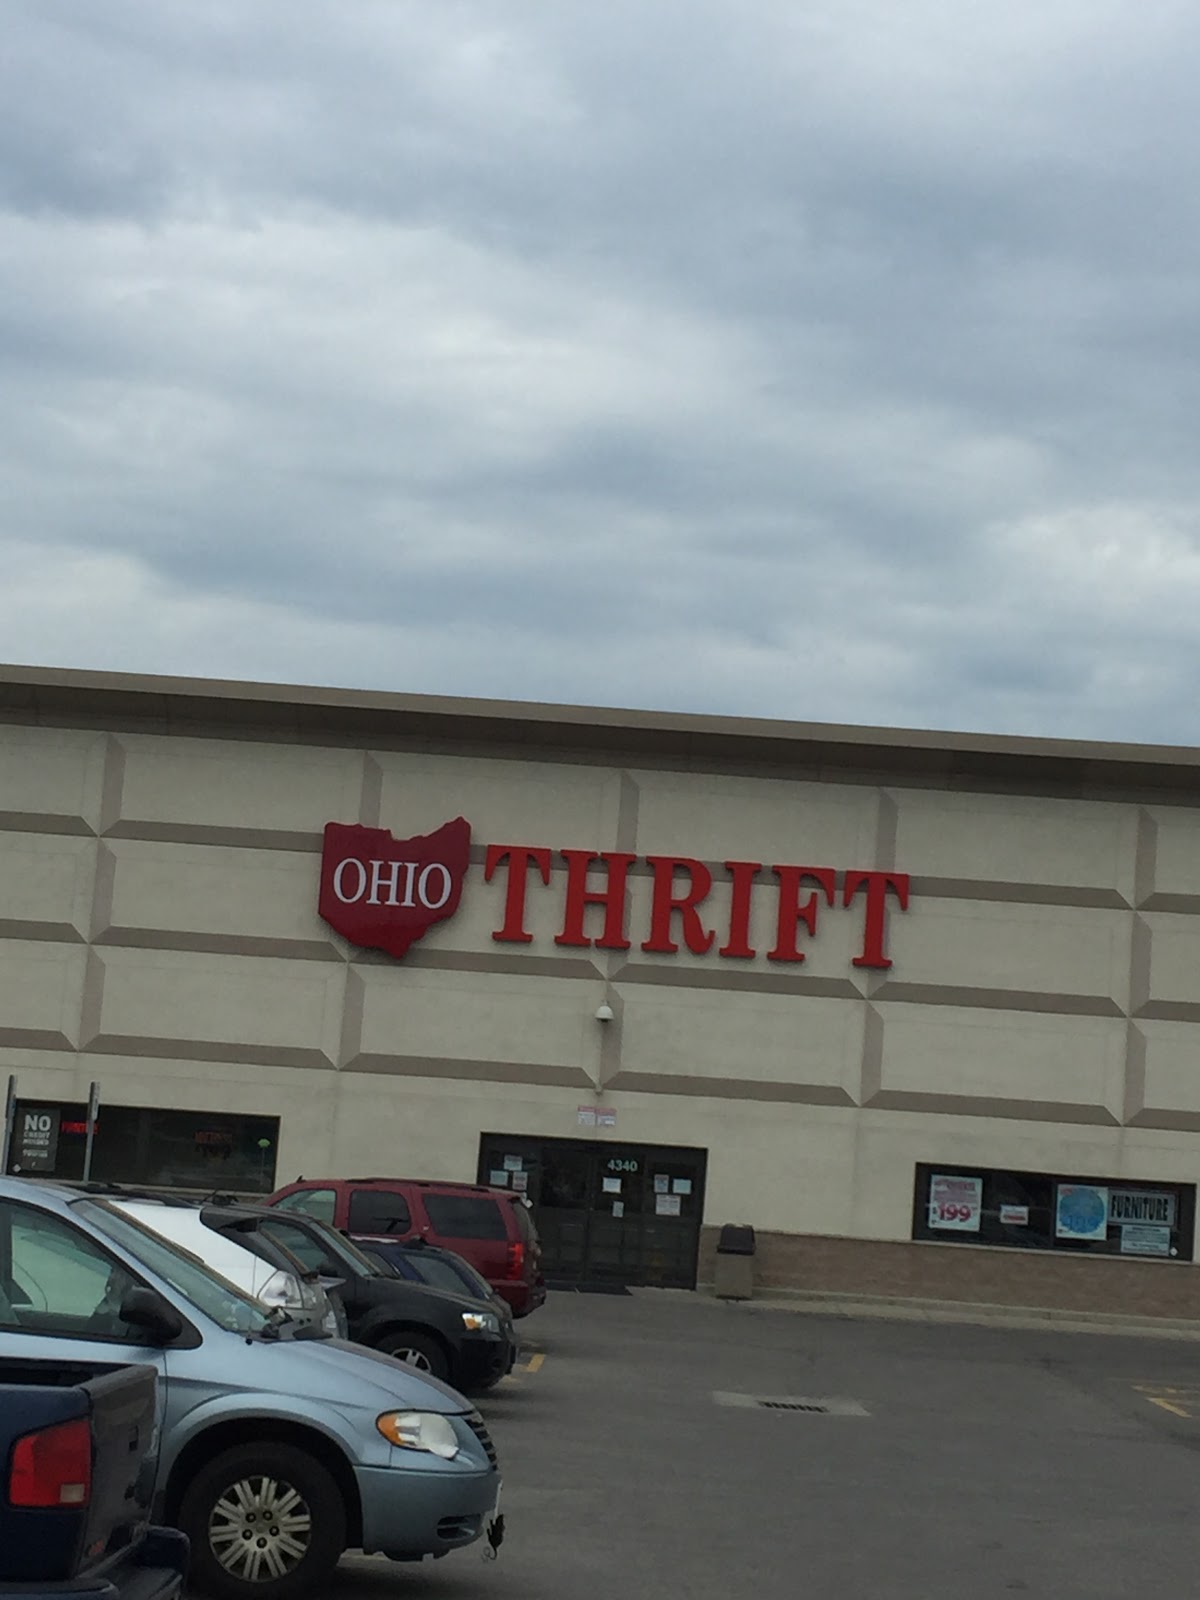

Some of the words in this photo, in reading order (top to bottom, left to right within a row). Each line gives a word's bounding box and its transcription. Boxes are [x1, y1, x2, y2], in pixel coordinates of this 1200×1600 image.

[333, 856, 452, 910] OHIO
[485, 845, 909, 968] THRIFT
[24, 1114, 51, 1130] NO
[607, 1159, 638, 1172] 4340
[1111, 1195, 1169, 1221] FURNITURE
